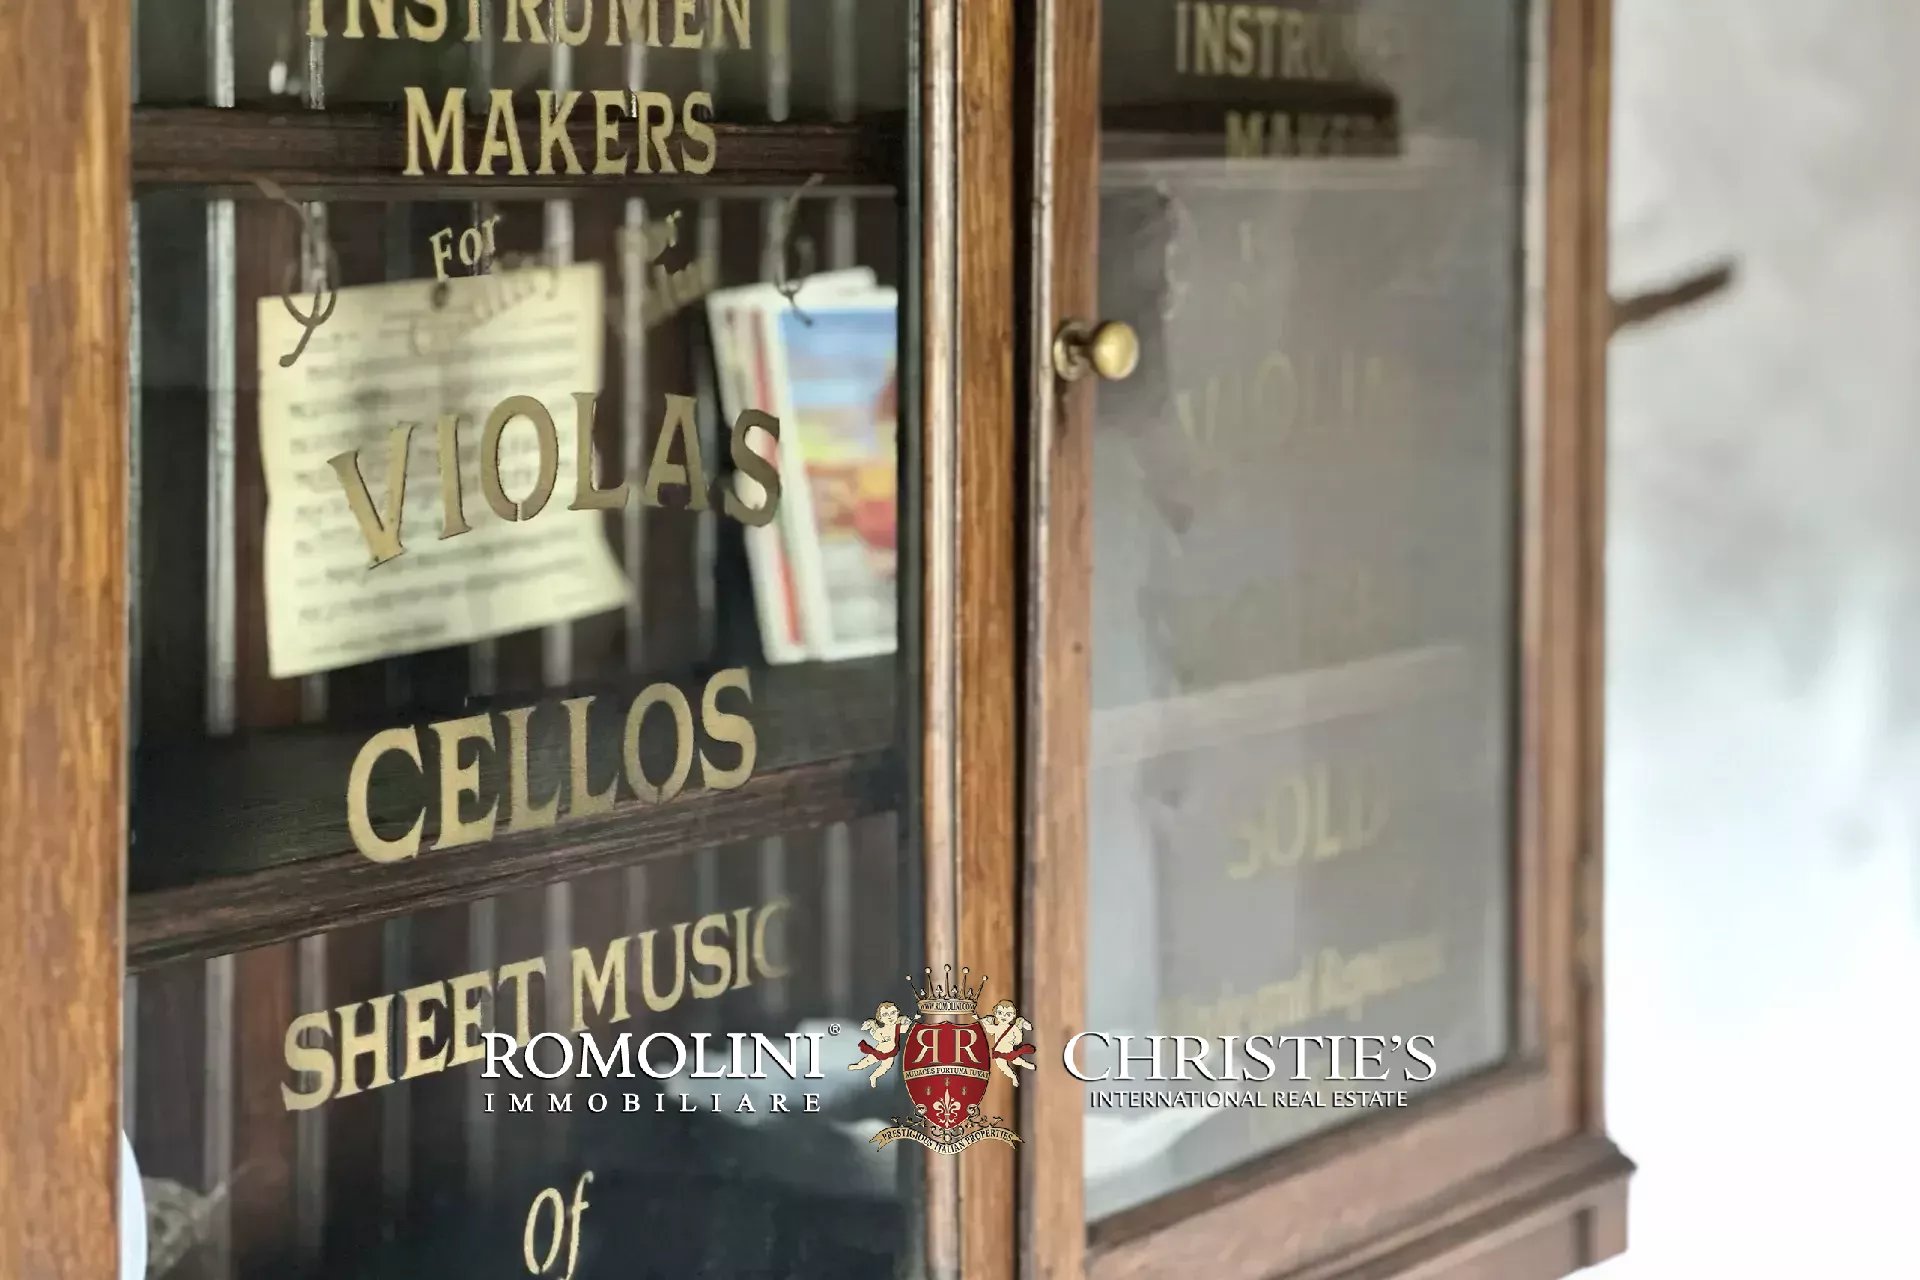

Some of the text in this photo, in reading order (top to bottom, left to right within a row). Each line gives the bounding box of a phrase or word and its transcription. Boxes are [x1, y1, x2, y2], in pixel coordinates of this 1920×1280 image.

[402, 87, 718, 176] MAKERS
[429, 213, 502, 283] For
[327, 391, 781, 570] VIOLAS
[346, 667, 758, 863] CELLOS
[280, 896, 794, 1111] SHEET MUSIC
[523, 1170, 594, 1280] Of
